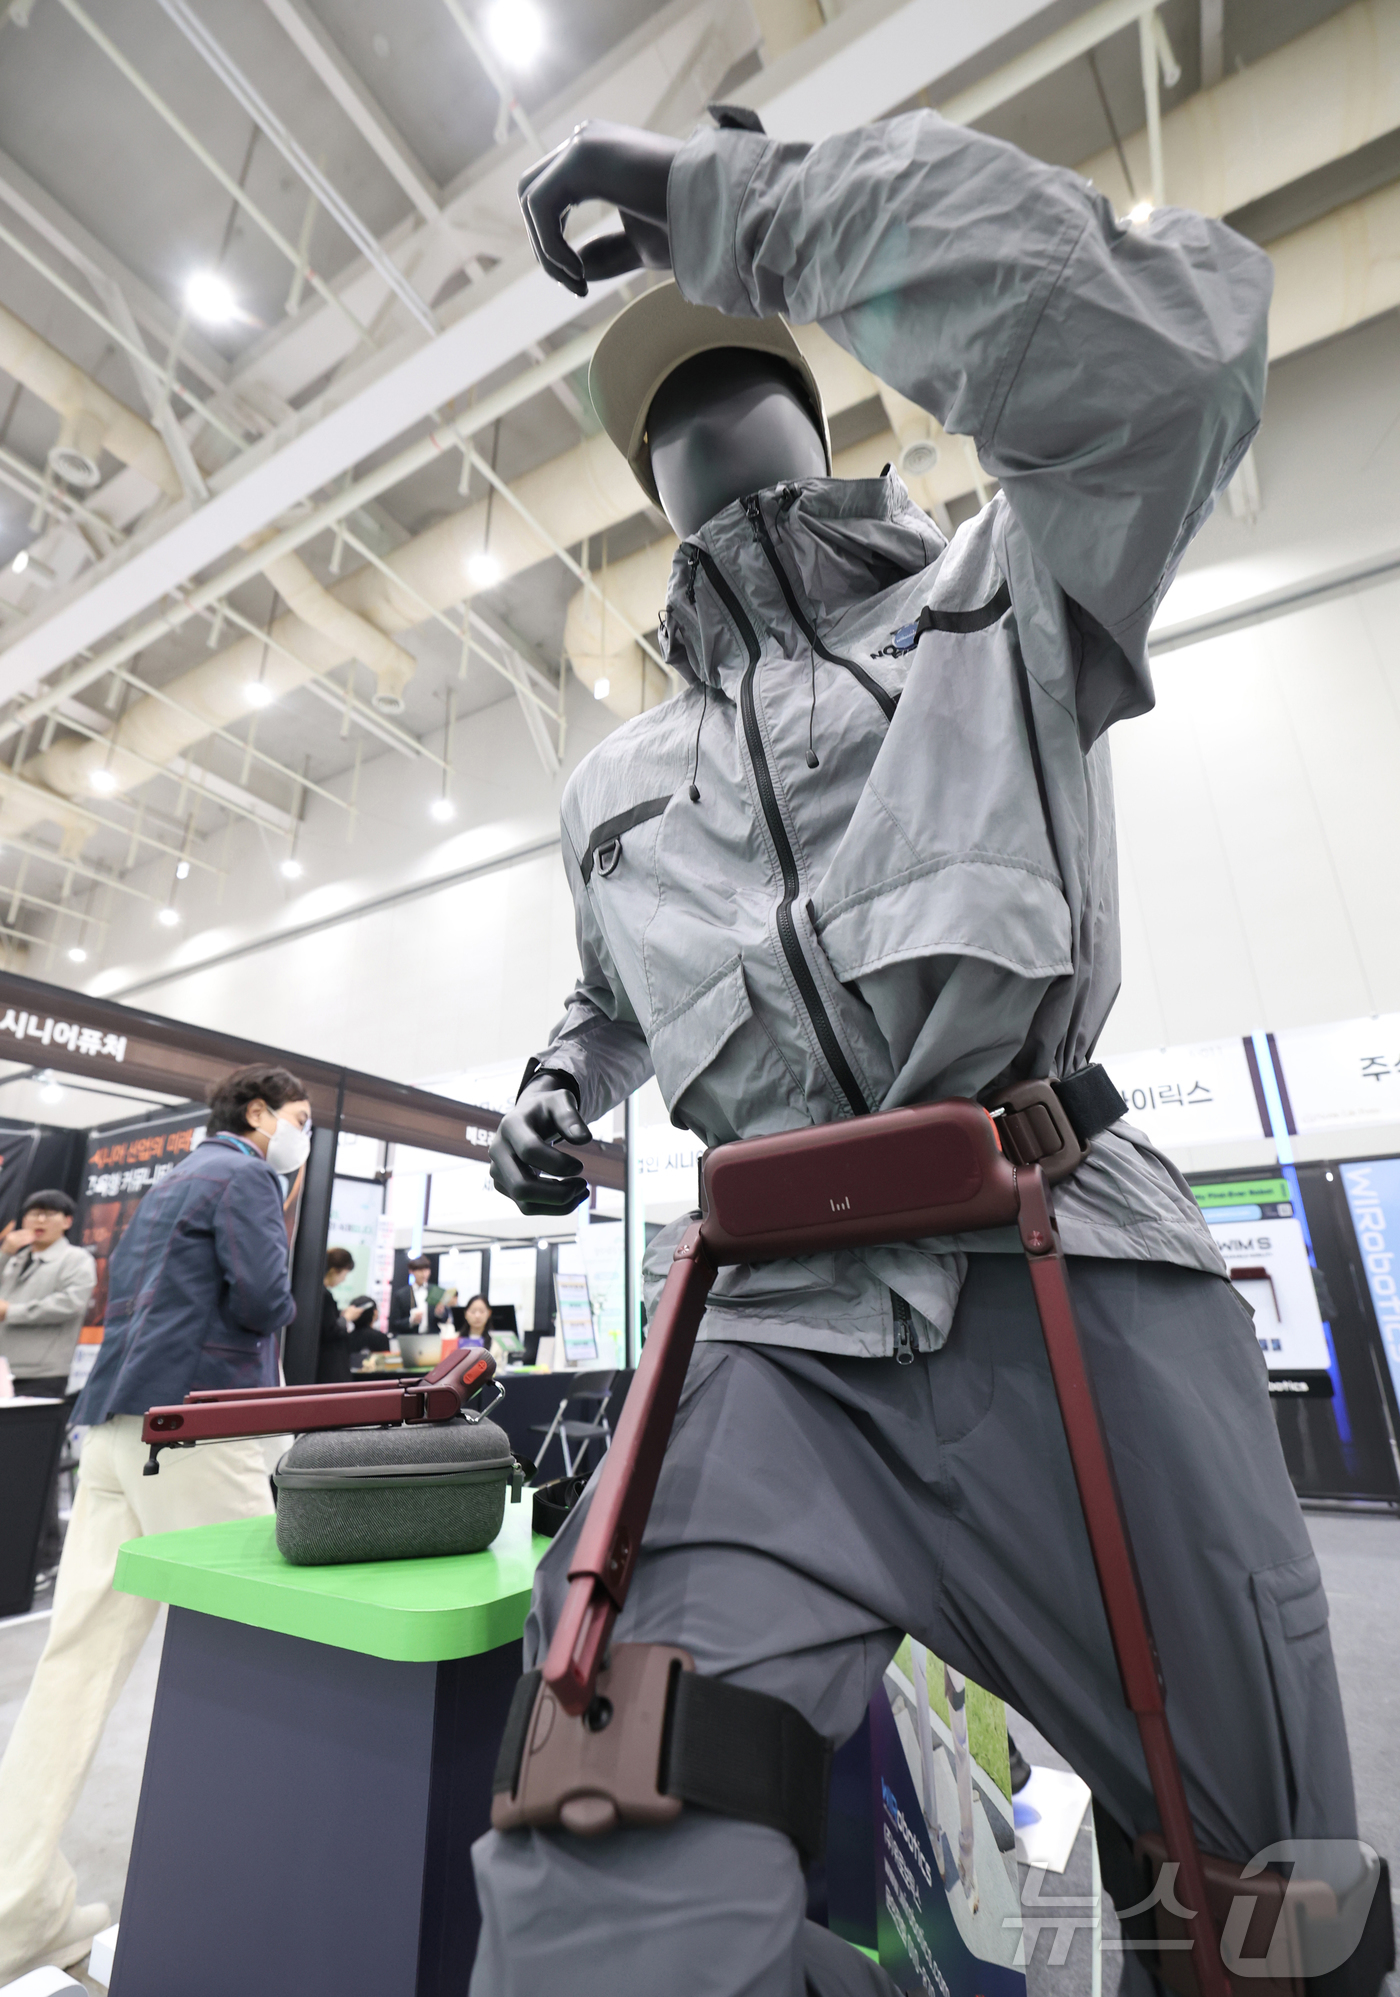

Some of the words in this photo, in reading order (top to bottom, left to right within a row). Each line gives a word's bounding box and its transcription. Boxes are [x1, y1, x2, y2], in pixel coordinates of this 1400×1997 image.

[0, 1008, 127, 1062] 시니어퓨처
[1360, 1054, 1400, 1082] 주
[1257, 1236, 1273, 1251] S
